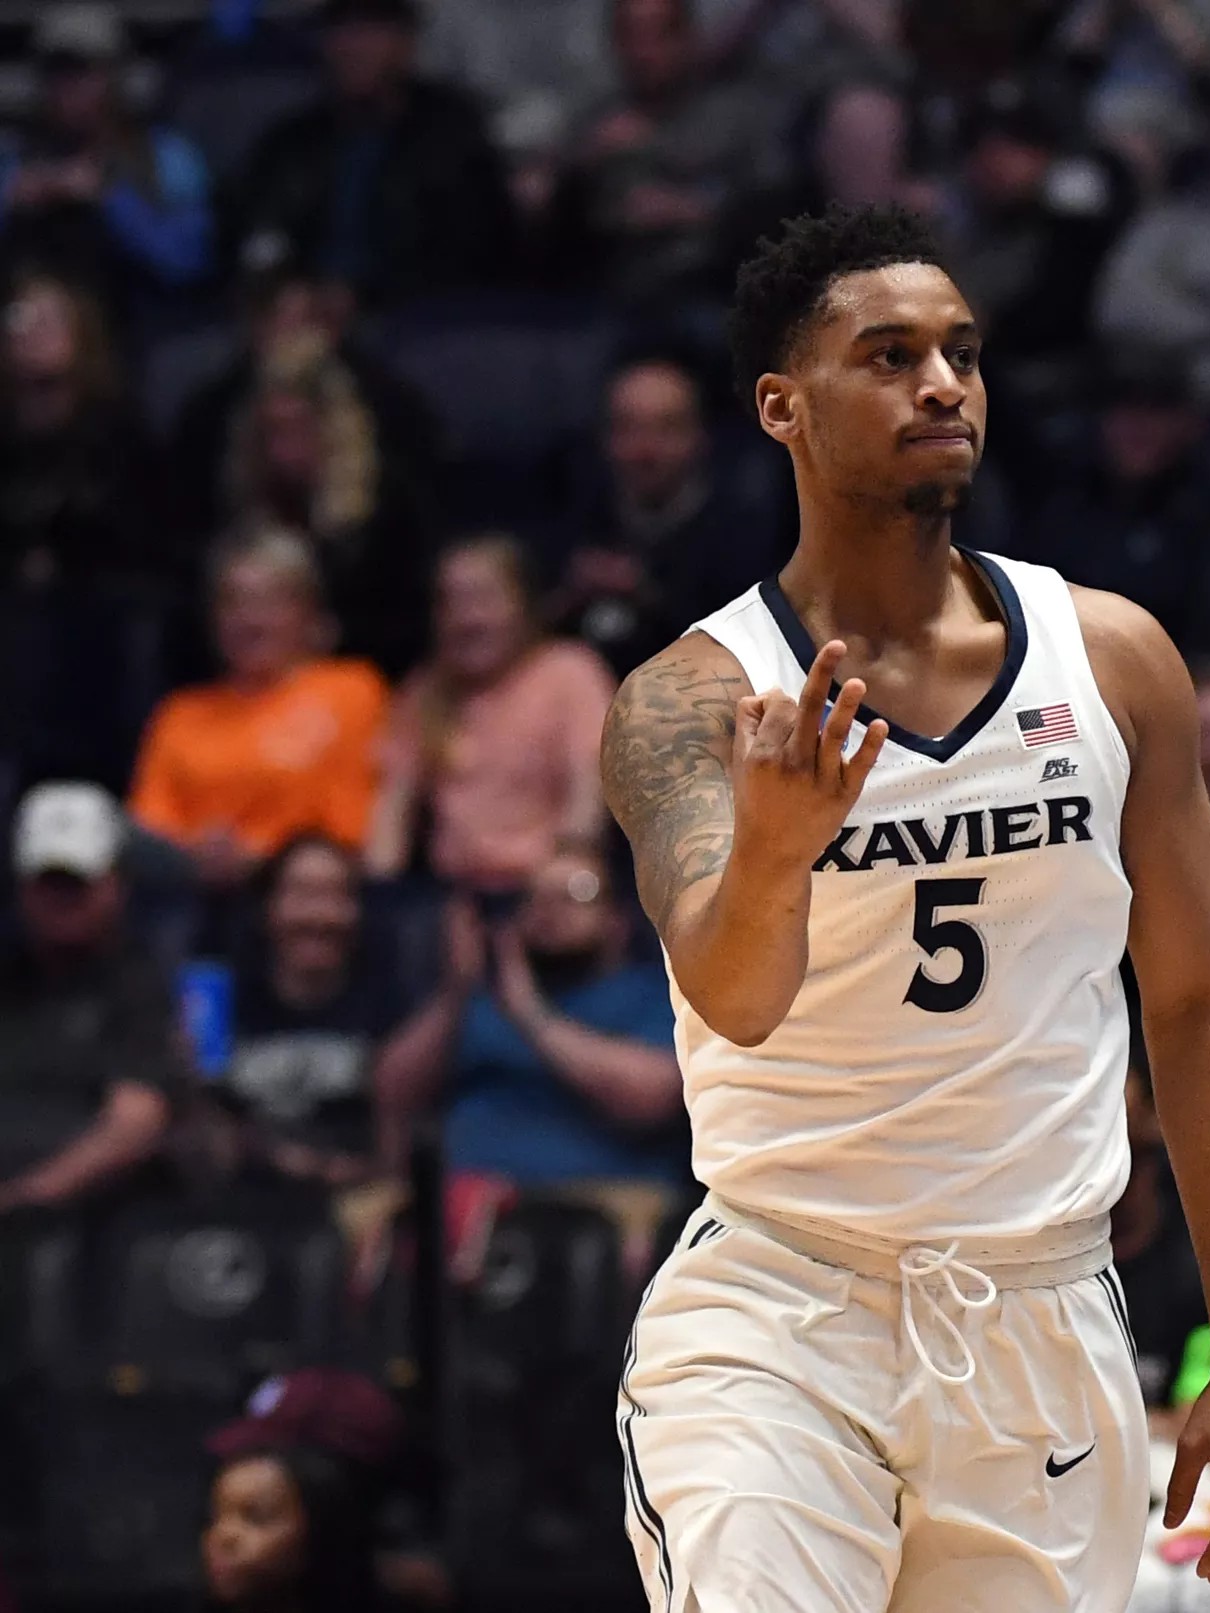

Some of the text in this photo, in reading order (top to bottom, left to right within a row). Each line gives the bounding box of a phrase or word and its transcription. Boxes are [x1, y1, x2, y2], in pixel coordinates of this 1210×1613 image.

[1041, 764, 1079, 779] EAST
[1045, 757, 1070, 768] BIG
[811, 796, 1094, 872] XAVIER
[902, 877, 989, 1014] 5
